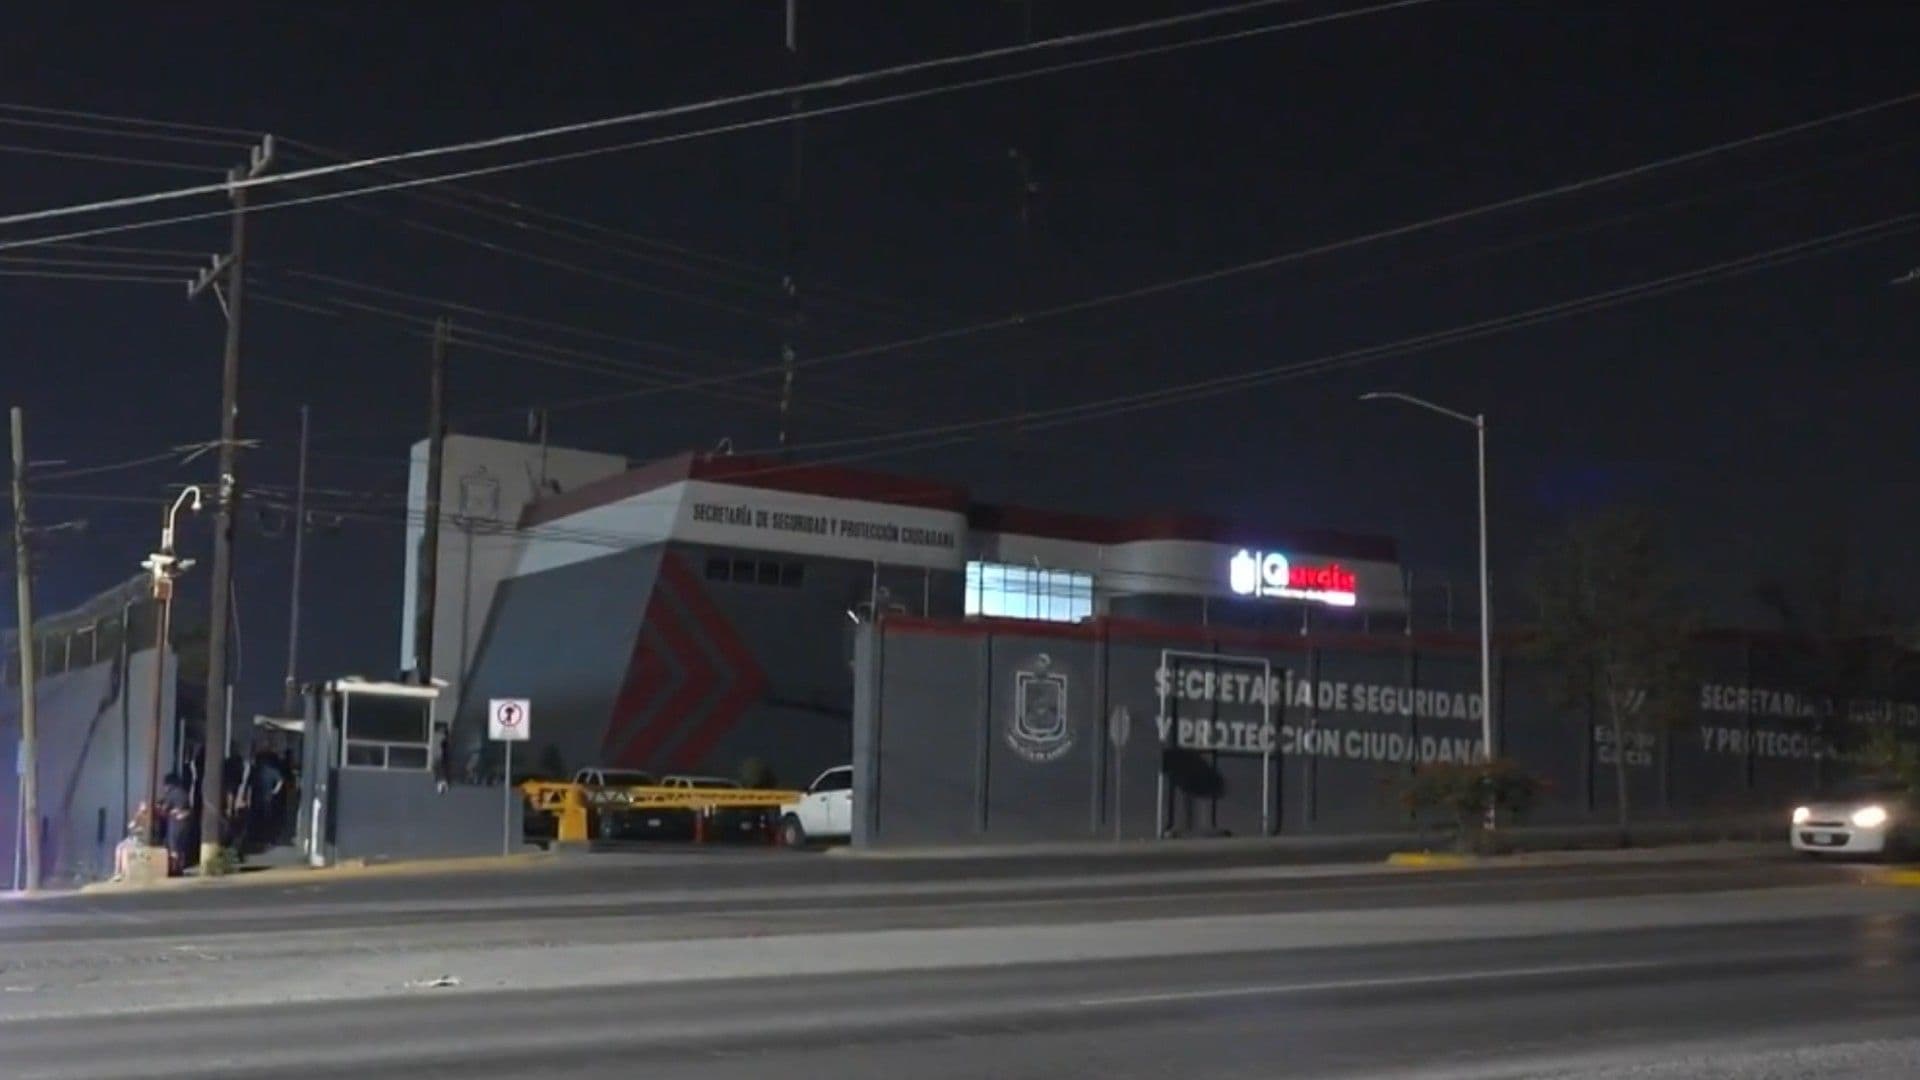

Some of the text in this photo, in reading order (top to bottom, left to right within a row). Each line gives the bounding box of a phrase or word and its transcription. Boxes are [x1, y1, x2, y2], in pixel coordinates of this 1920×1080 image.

[693, 503, 955, 549] SECRETARÍA DE SEGURIDAD Y PROTECCIÓN CIUDADANA
[1318, 680, 1348, 710] DE
[1349, 683, 1484, 721] SEGURIDAD
[1156, 716, 1490, 766] Y PROTECCIÓN CIUDADANA
[1702, 726, 1714, 752] Y
